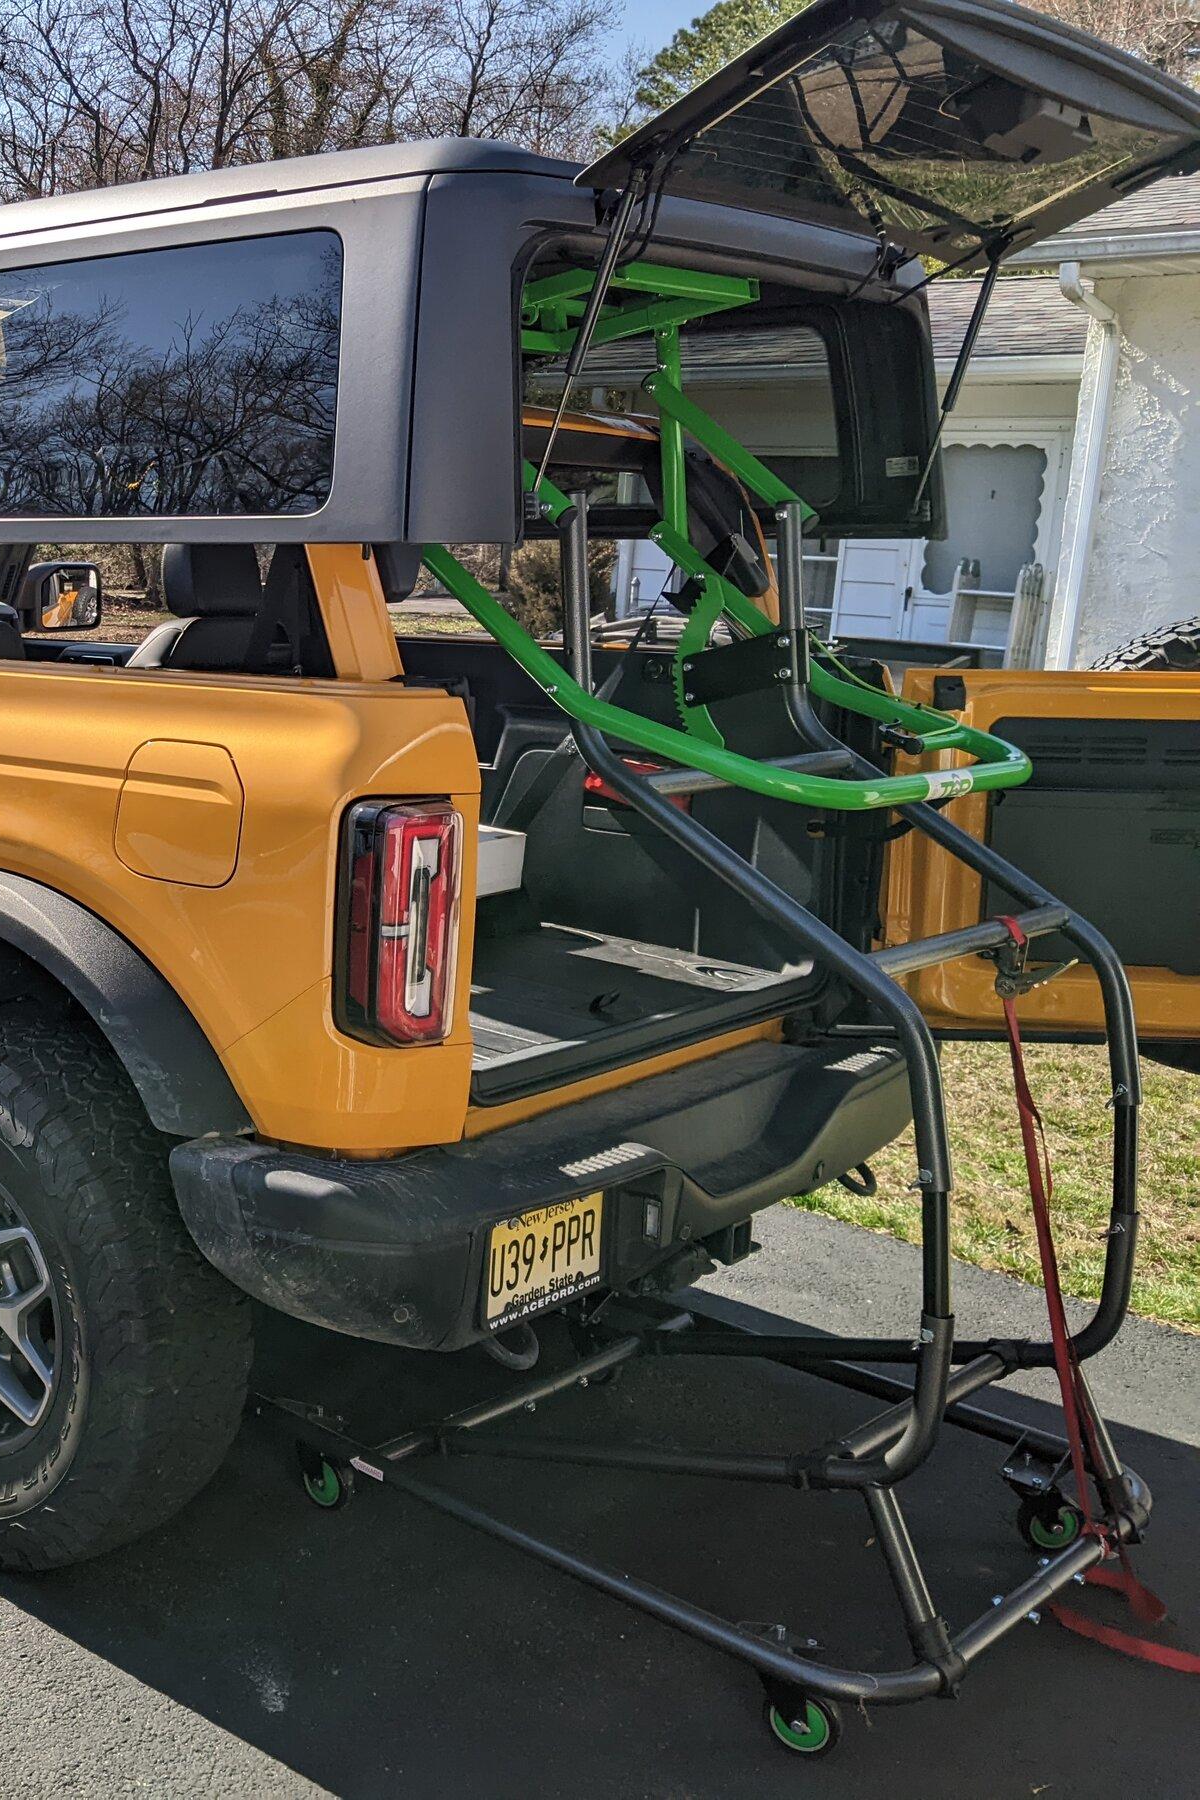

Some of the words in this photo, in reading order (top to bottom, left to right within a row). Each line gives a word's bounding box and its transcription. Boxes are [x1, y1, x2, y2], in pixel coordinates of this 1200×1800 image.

[516, 1213, 542, 1231] New
[543, 1200, 576, 1224] Jersey
[490, 1233, 536, 1298] U39
[551, 1209, 596, 1273] PPR
[489, 1275, 601, 1330] www.ACEFORD.com
[512, 1287, 546, 1307] Garden
[548, 1272, 575, 1292] State
